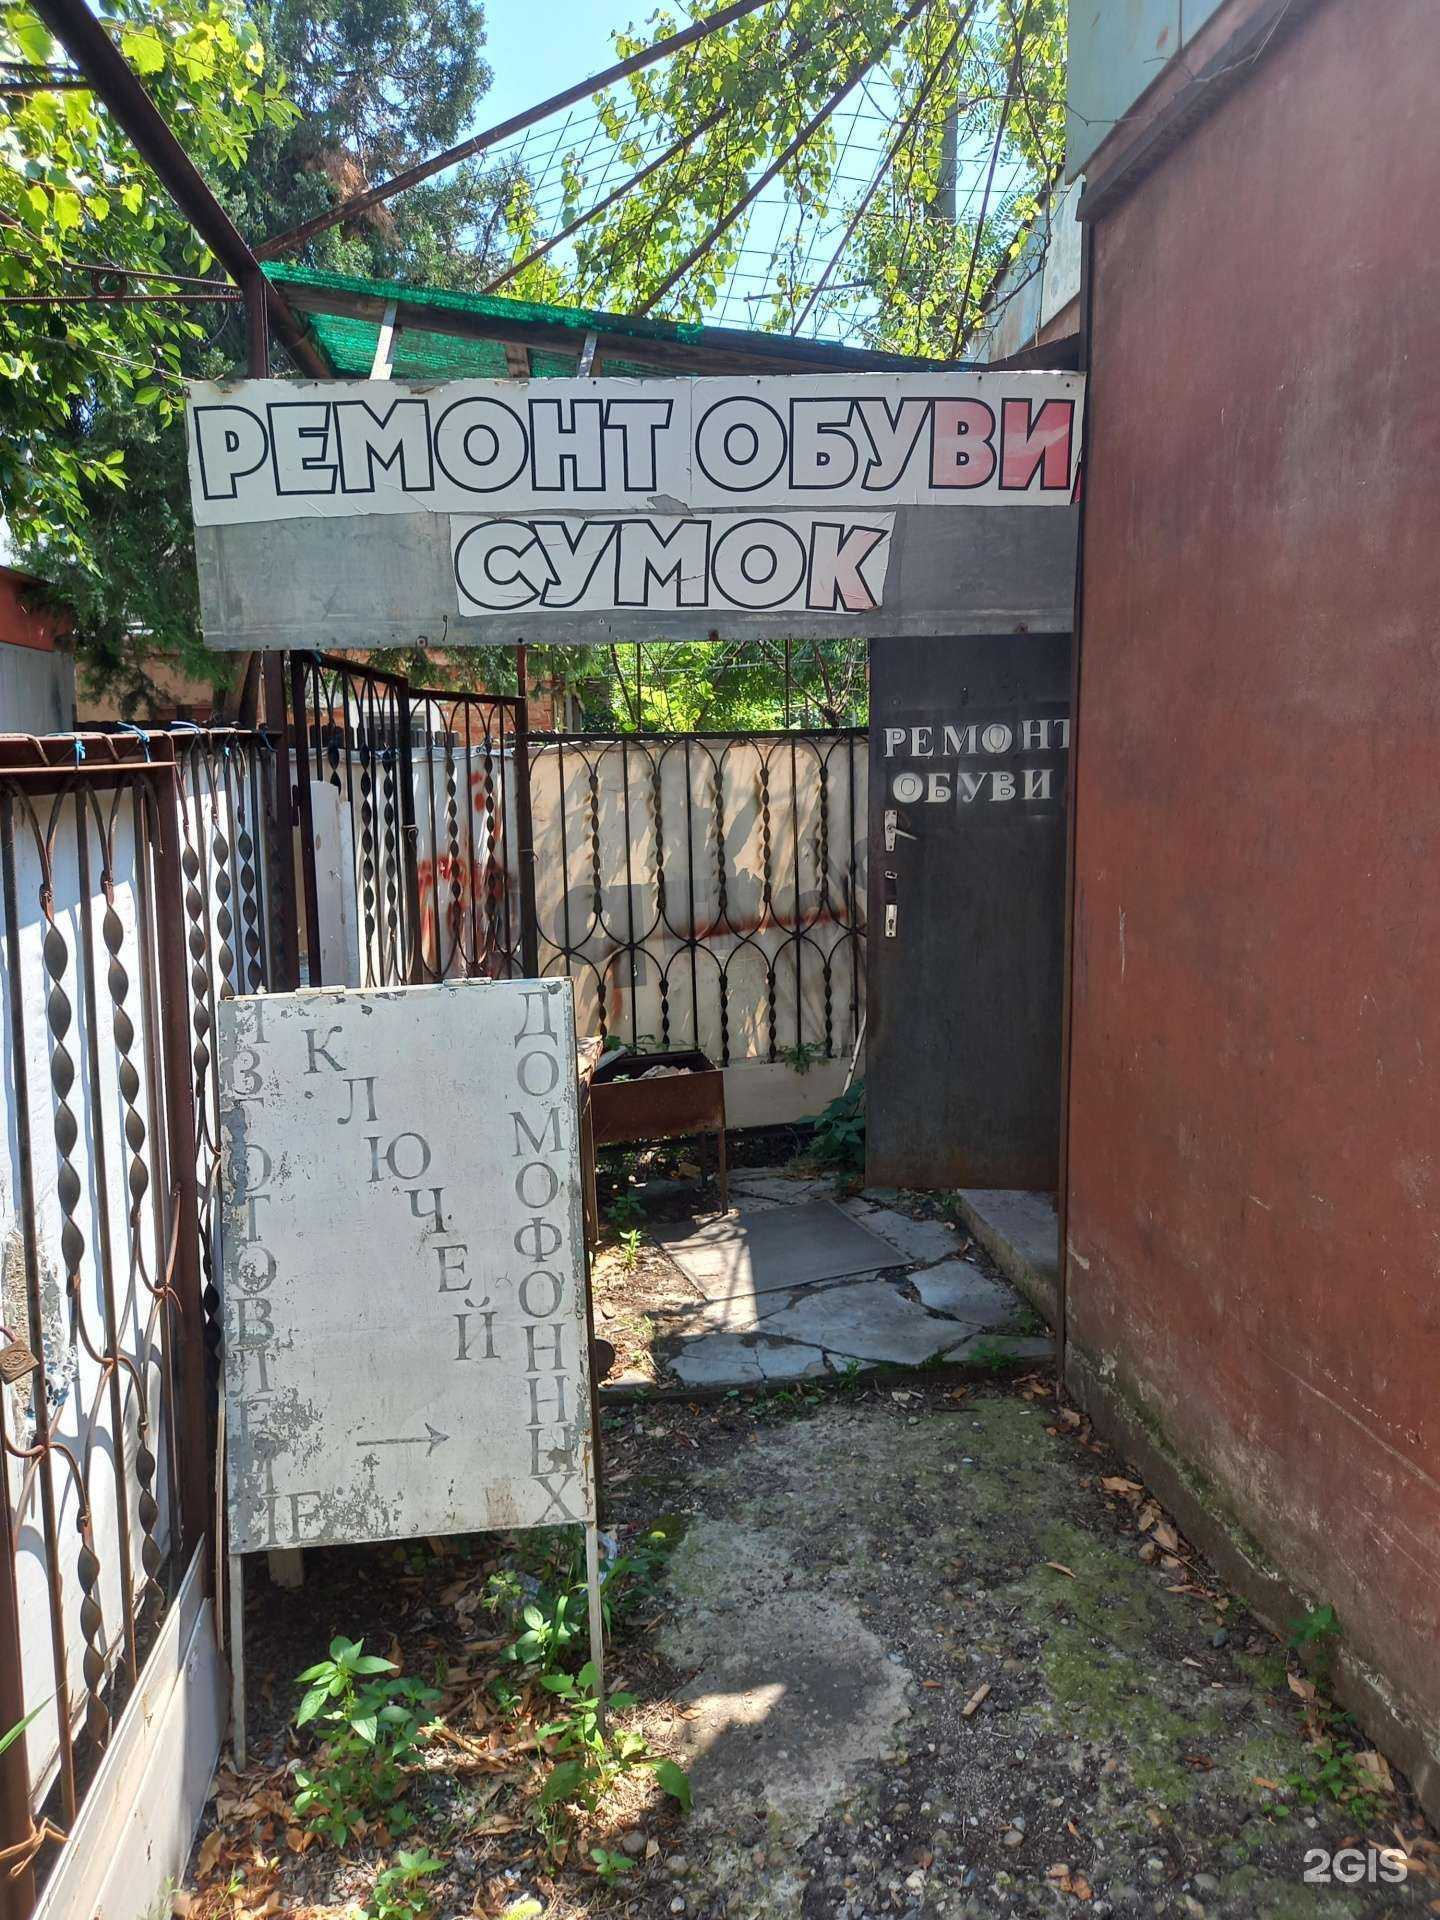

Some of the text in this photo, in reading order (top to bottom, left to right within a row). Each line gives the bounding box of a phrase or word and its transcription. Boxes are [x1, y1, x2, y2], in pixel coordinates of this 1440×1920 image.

[194, 395, 1077, 500] РЕМОНТ ОБУВИ
[454, 517, 885, 613] СУМОК
[882, 718, 1071, 758] РЕМОНТ
[892, 768, 1054, 803] ОБУВИ
[303, 1025, 502, 1362] КЛЮЧЕЙ
[508, 991, 581, 1525] ДОМОФОННЫХ
